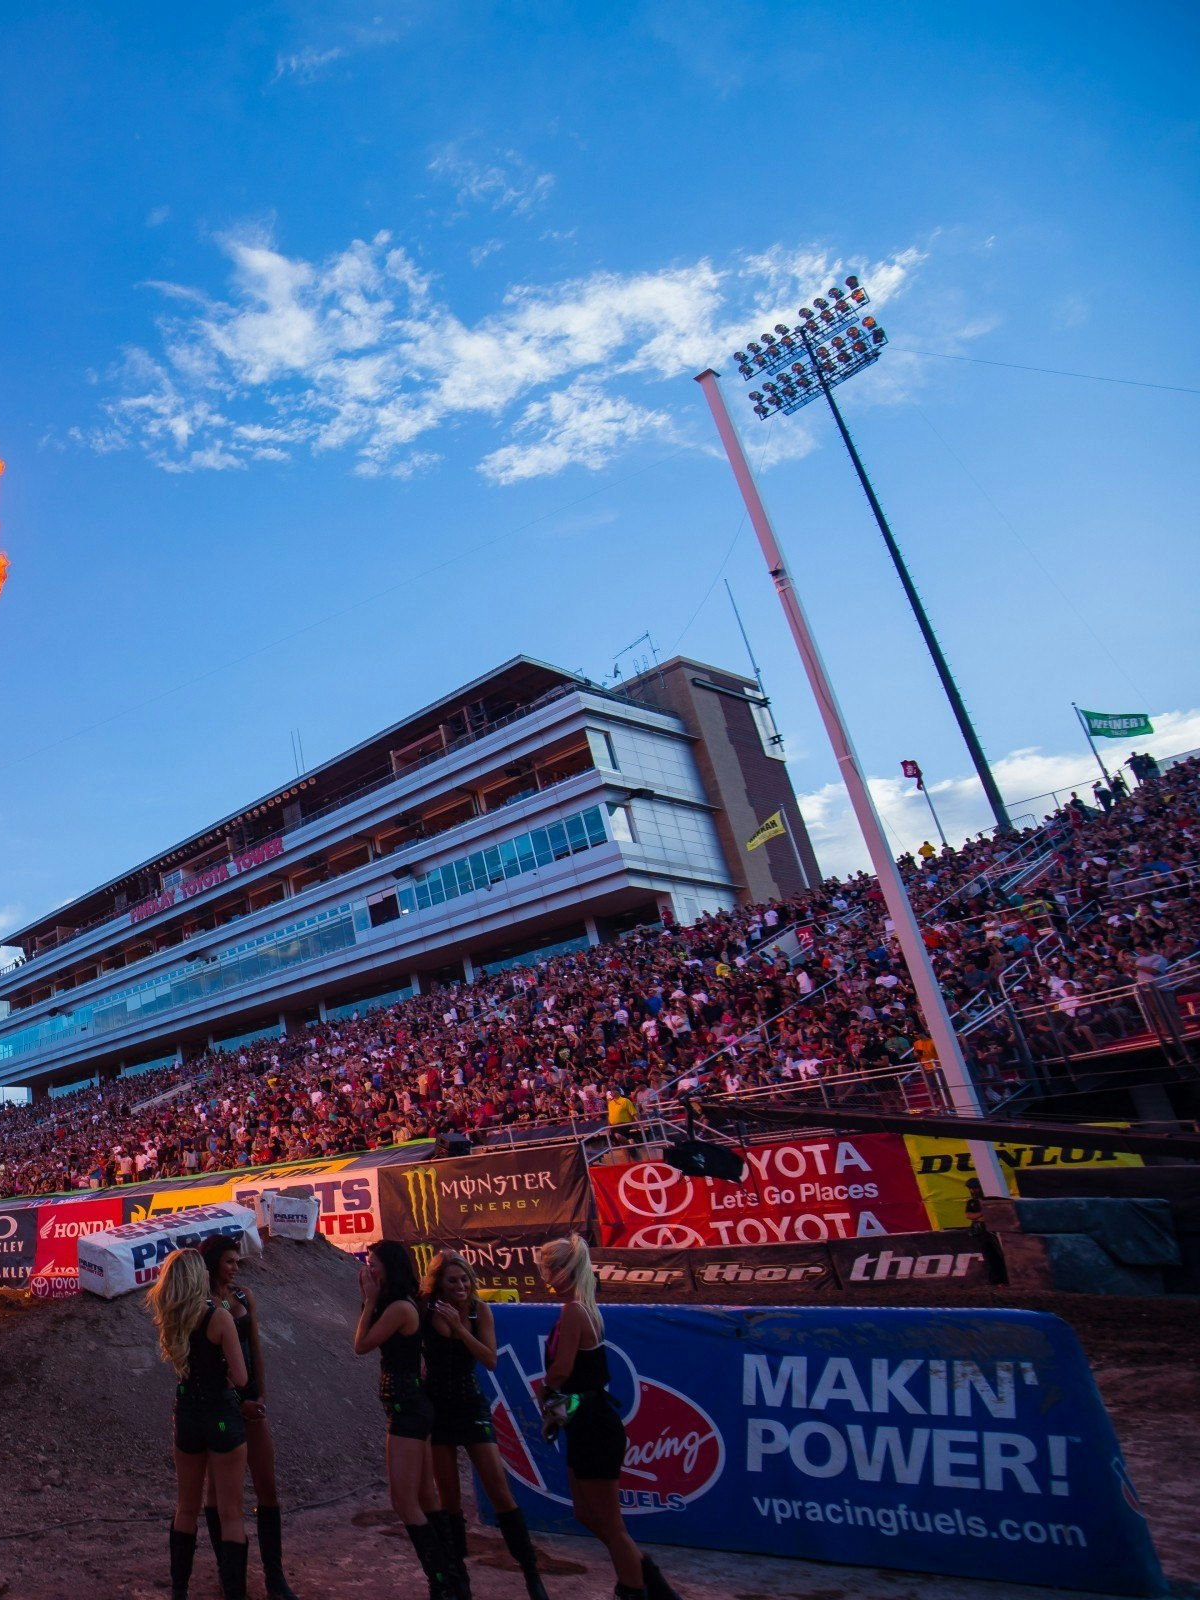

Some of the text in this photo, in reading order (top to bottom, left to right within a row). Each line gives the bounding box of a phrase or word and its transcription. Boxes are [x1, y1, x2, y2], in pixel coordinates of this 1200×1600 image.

[130, 835, 285, 924] FINDLAY TOYOTA TOWER
[459, 1199, 541, 1213] ENERGY
[710, 1182, 879, 1210] Let's Go Places
[54, 1219, 115, 1238] HONDA
[709, 1211, 888, 1245] TOYOTA
[79, 1258, 103, 1272] PARTS
[701, 1262, 827, 1283] thor
[850, 1250, 985, 1281] thor
[742, 1353, 1040, 1420] MAKIN'
[746, 1418, 1071, 1498] POWER!
[619, 1488, 687, 1512] UELS
[752, 1496, 1089, 1548] vpracingfuels.com
